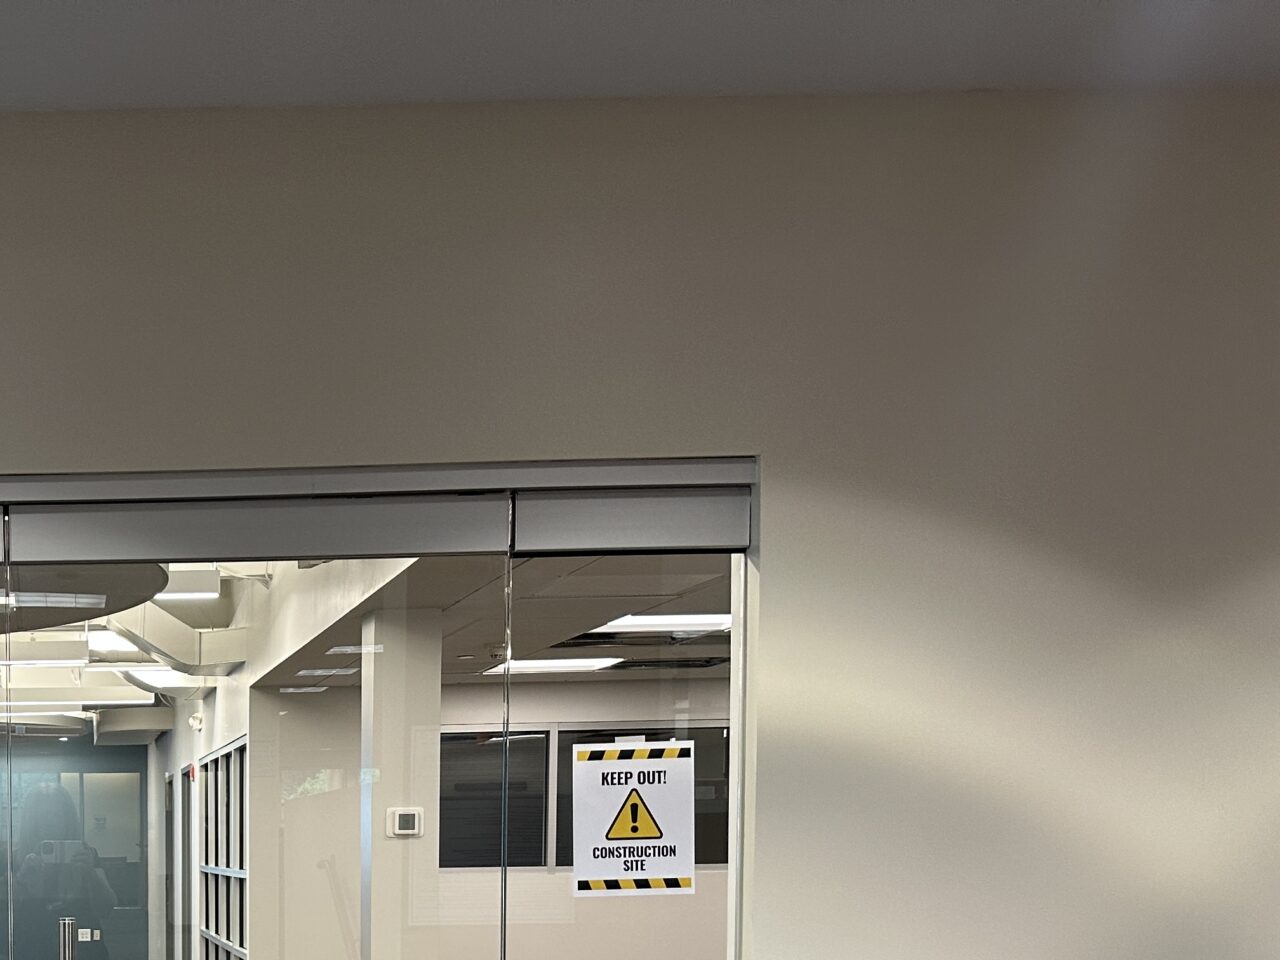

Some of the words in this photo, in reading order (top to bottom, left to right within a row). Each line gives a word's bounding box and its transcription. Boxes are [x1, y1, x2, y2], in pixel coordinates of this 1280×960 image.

[601, 771, 633, 786] KEEP
[637, 770, 667, 785] OUT!
[593, 845, 676, 858] CONSTRUCTION
[623, 859, 646, 872] SITE
